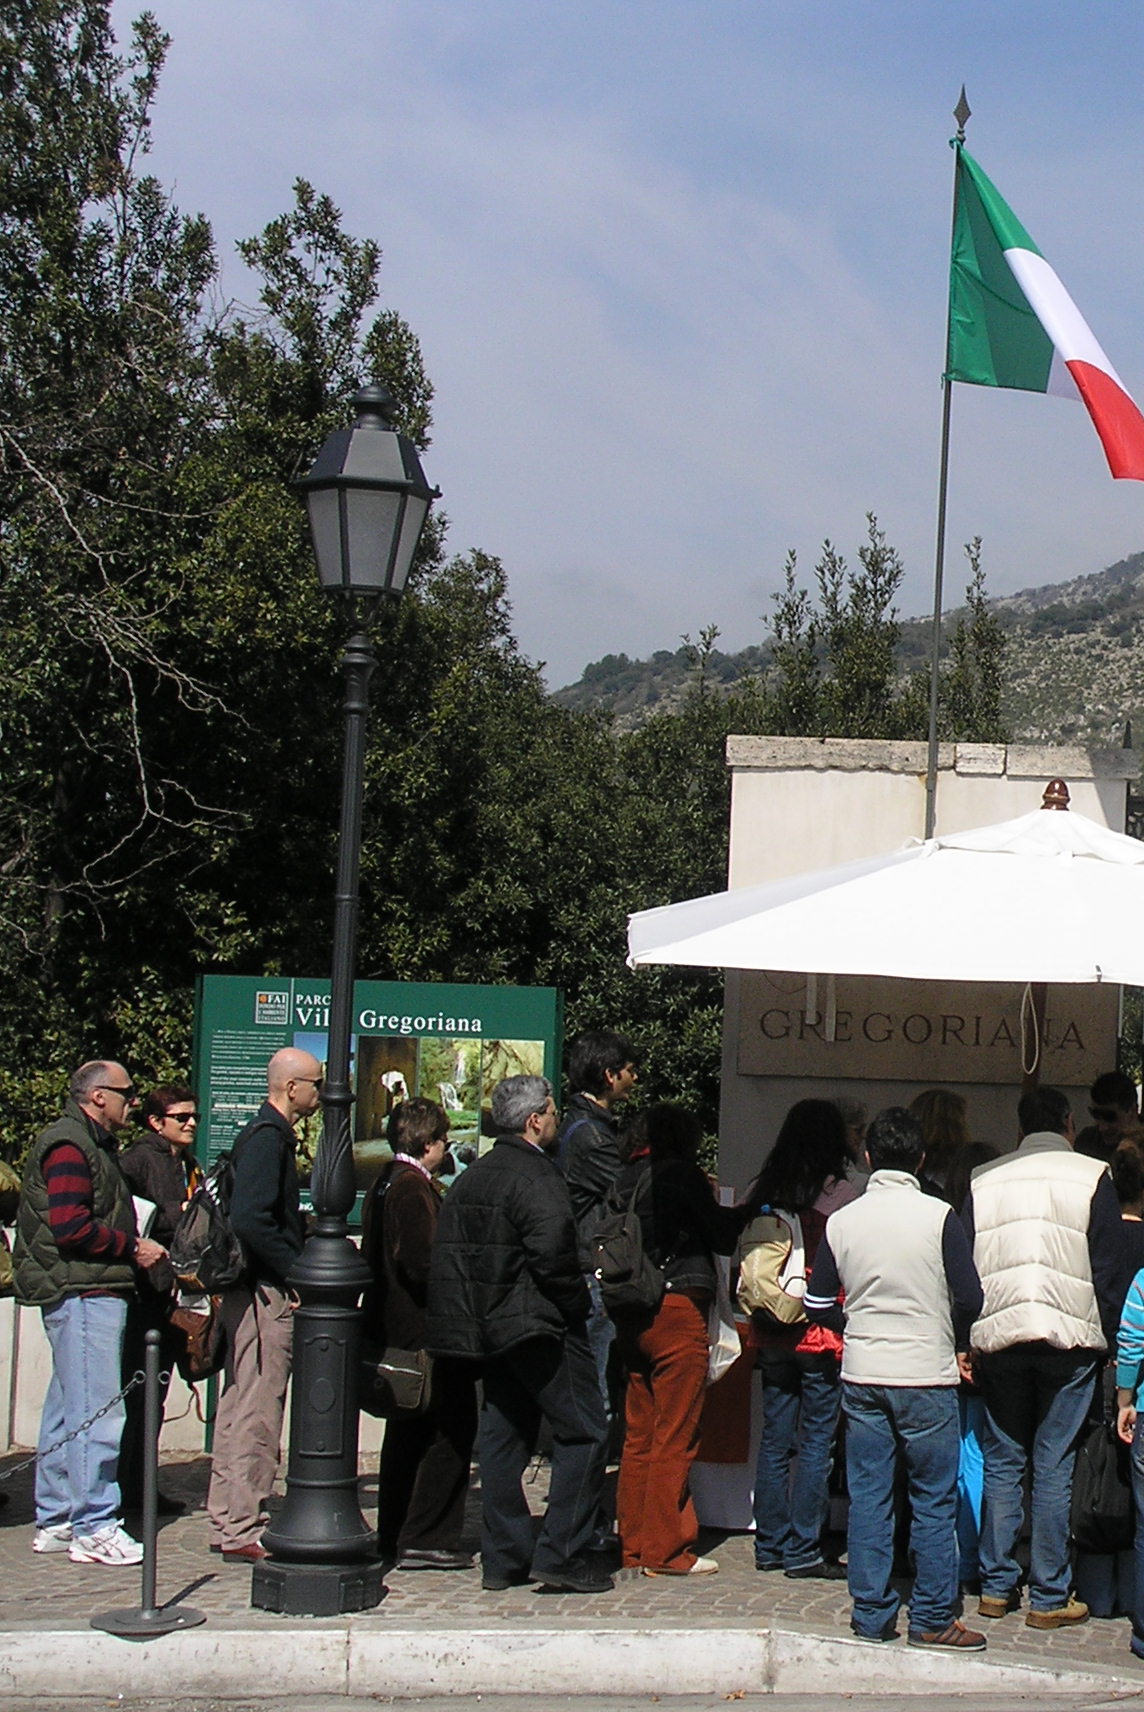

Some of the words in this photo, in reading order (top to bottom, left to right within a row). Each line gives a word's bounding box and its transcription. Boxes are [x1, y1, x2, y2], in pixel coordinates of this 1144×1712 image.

[268, 995, 286, 1004] FAI
[296, 994, 331, 1005] PARC
[295, 1007, 330, 1027] Vil
[359, 1009, 482, 1034] Gregoriana
